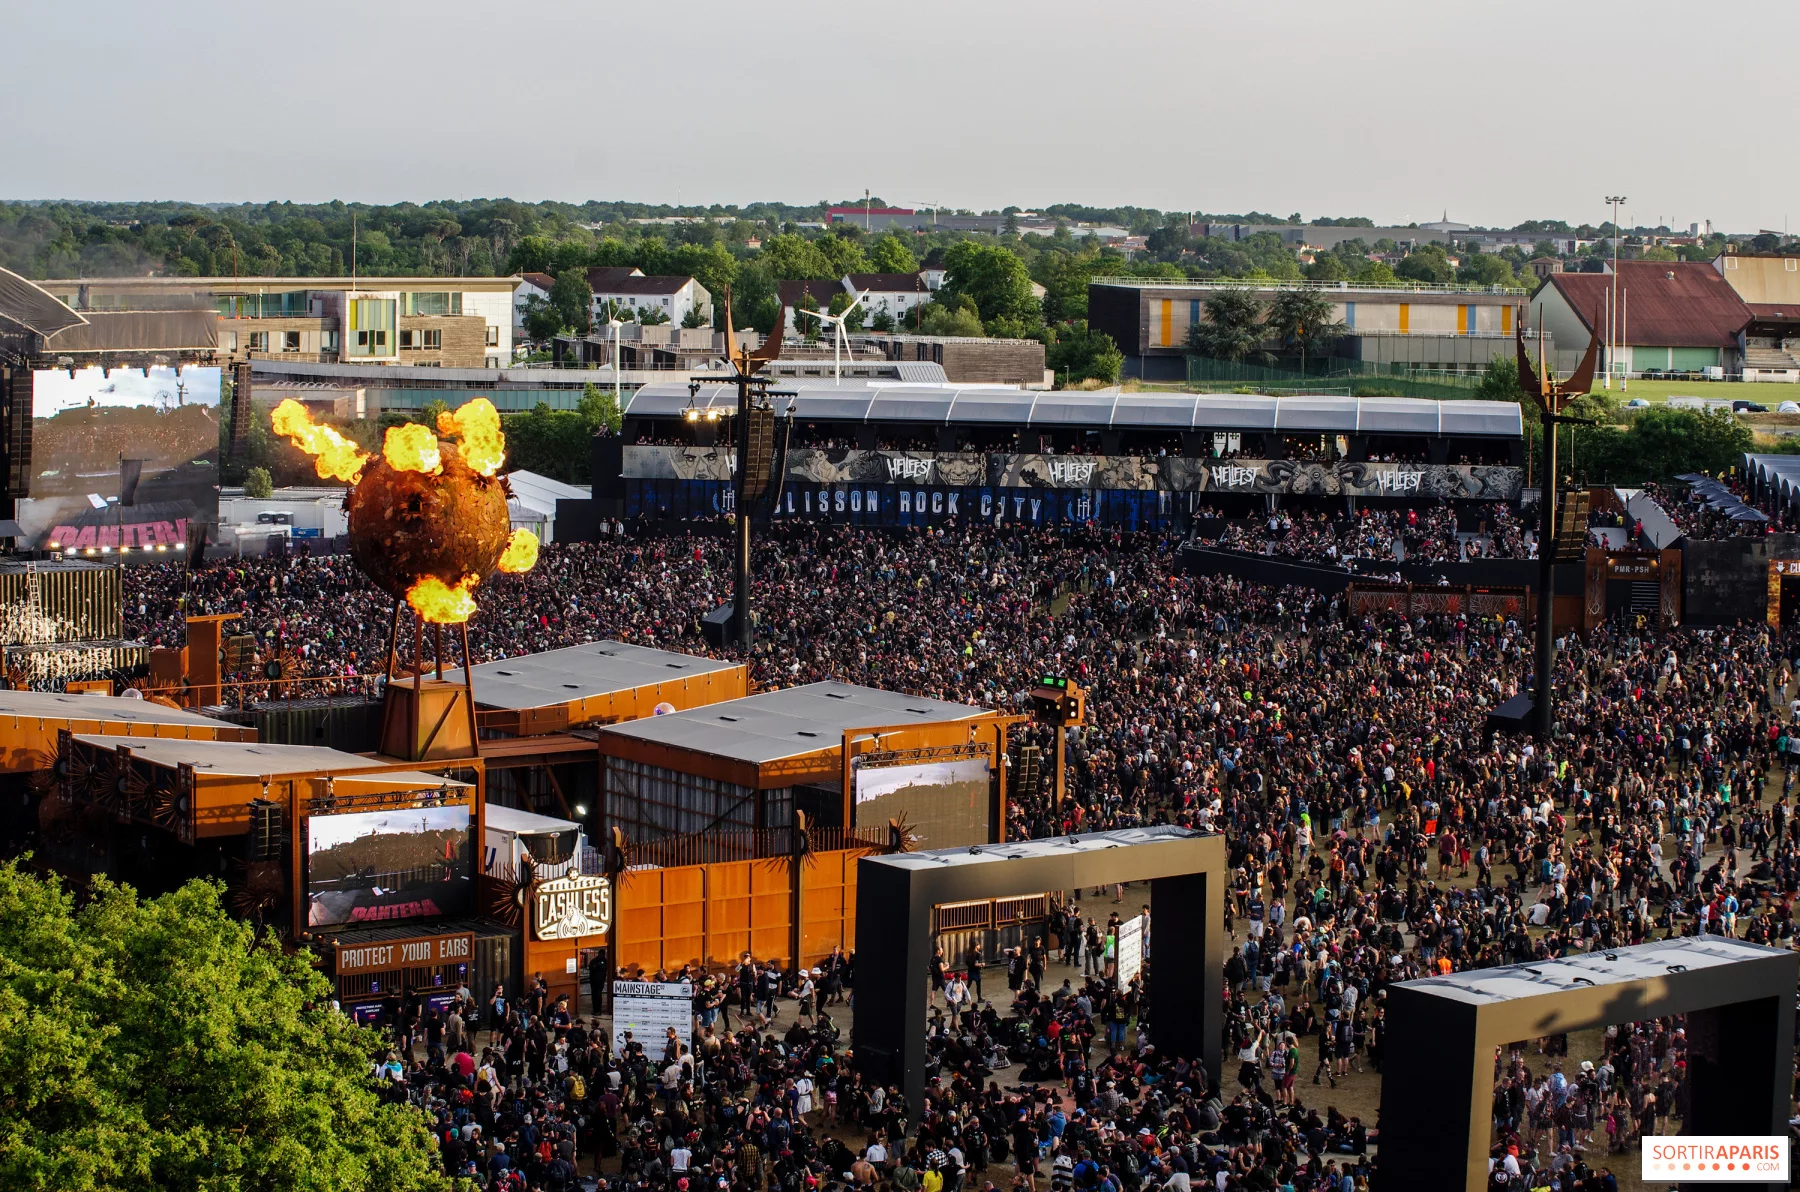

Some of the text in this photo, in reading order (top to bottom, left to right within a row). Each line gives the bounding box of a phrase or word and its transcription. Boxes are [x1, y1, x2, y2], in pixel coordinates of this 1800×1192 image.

[887, 458, 936, 479] HELLFEST
[1048, 461, 1098, 484] HELLFEST
[1211, 465, 1261, 488] HELLFEST
[1376, 469, 1426, 492] HELLFEST
[774, 490, 878, 514] LISSON
[900, 491, 960, 515] ROCK
[1614, 565, 1650, 574] PMR-PSH
[549, 879, 597, 891] HELLFEST
[539, 888, 609, 928] CASHLESS
[341, 937, 469, 969] PROTECT YOUR EARS
